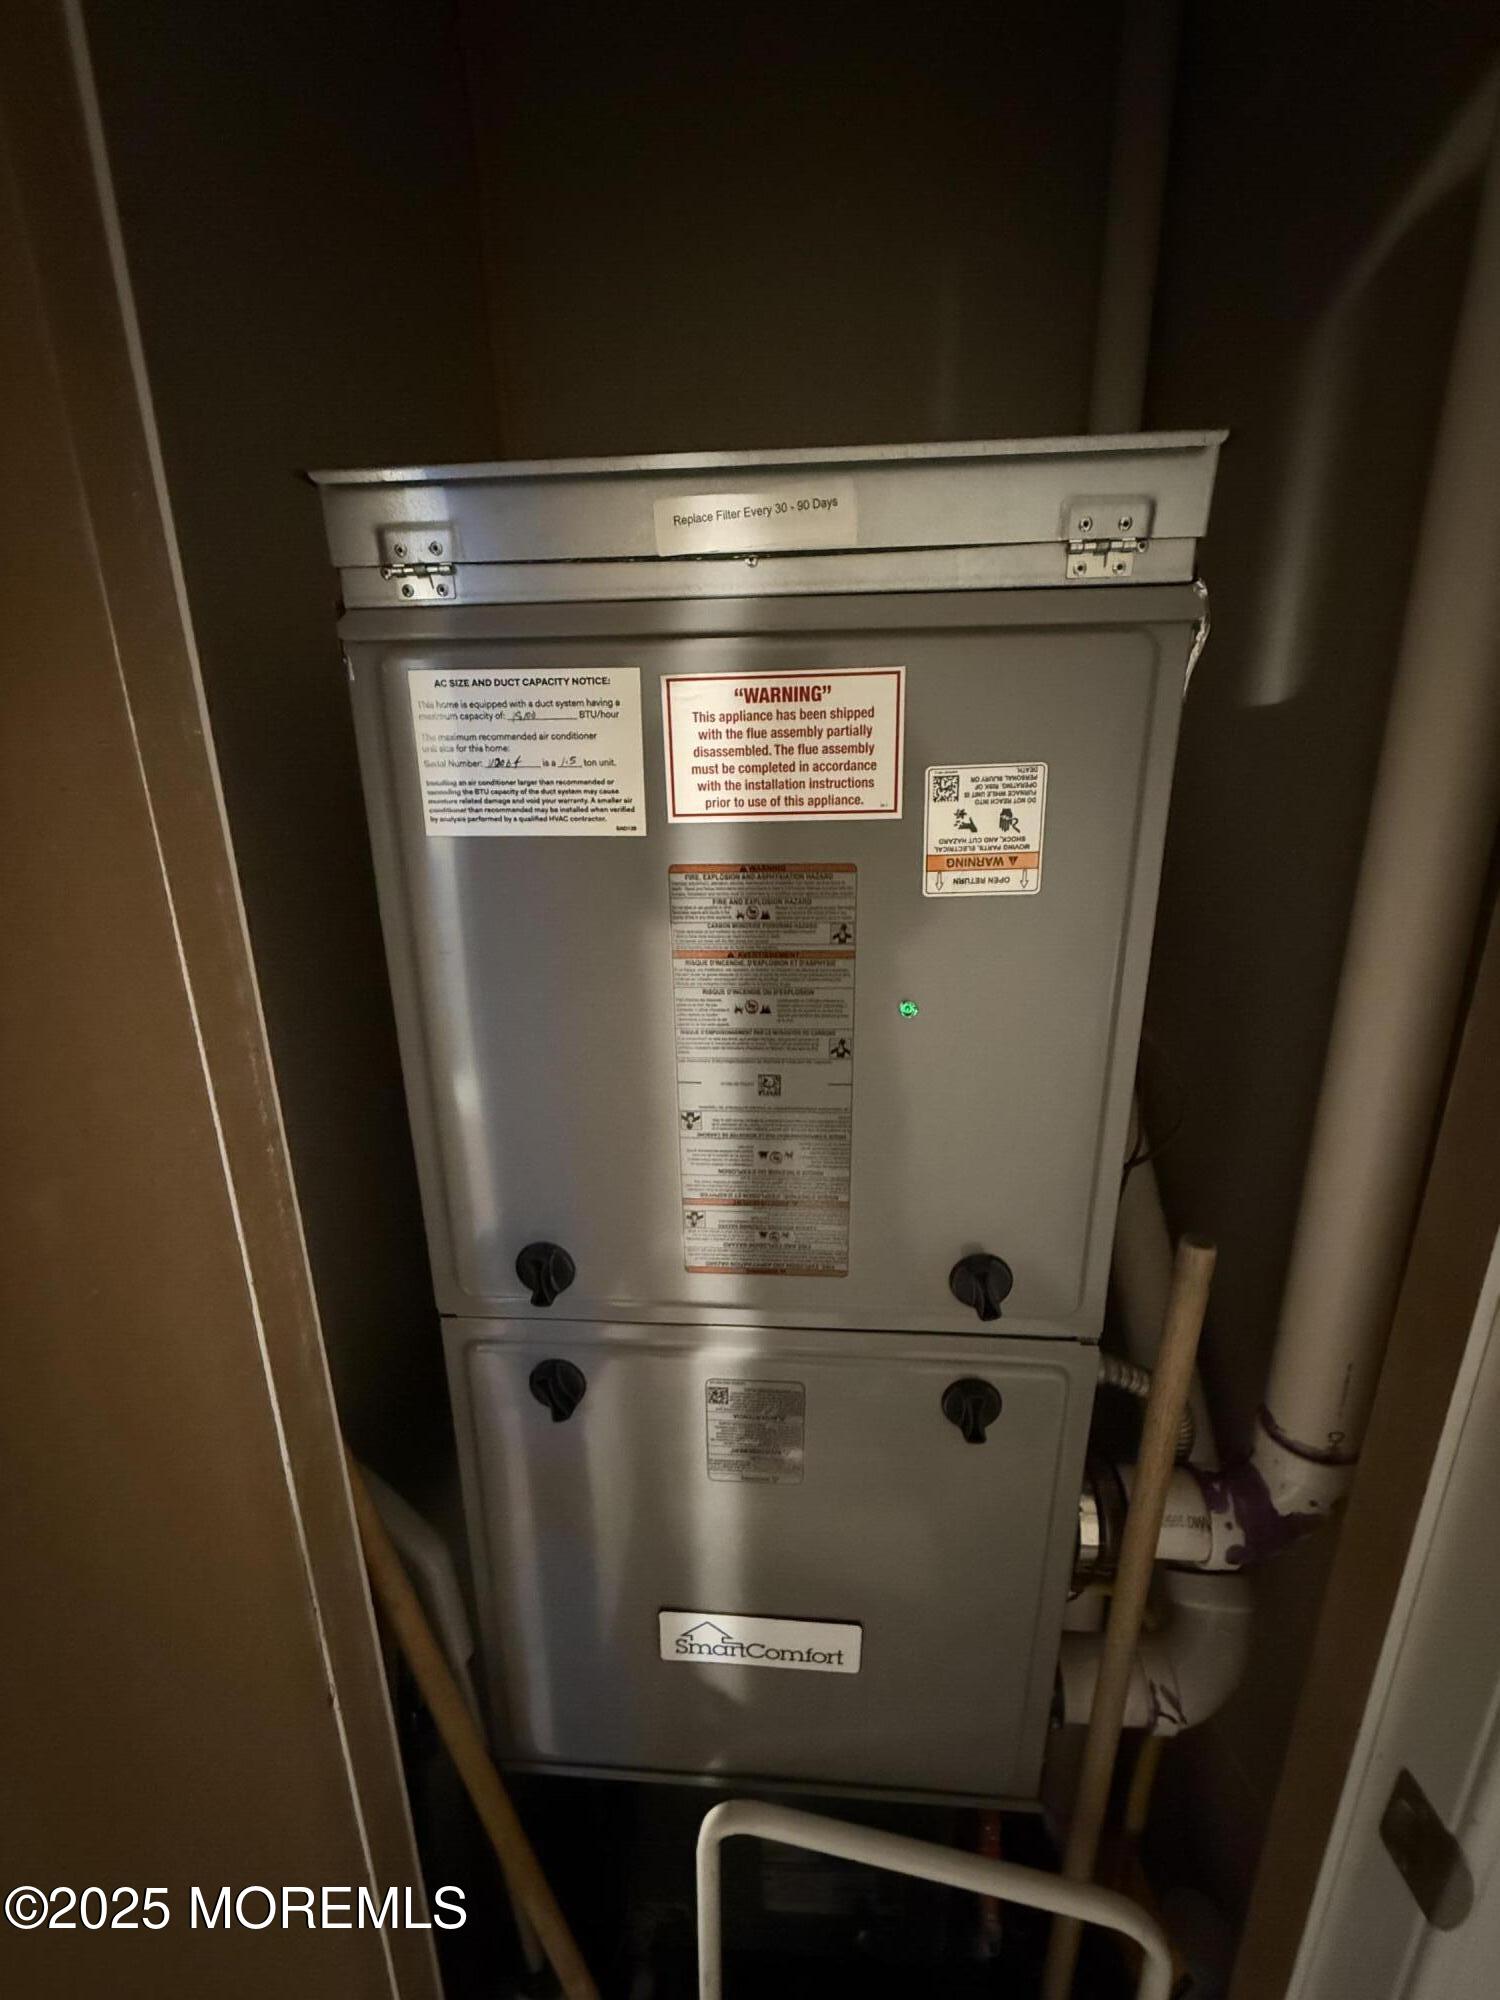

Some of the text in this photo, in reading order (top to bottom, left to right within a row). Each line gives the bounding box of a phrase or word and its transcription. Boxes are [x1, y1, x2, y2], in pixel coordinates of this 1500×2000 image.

[673, 513, 713, 526] Replace
[716, 510, 741, 520] Filter
[744, 506, 772, 518] Every
[775, 503, 787, 514] 30
[798, 500, 810, 511] 90
[813, 496, 838, 510] Days
[435, 679, 447, 688] AC
[450, 679, 469, 687] SIZE
[494, 678, 520, 686] DUCT
[522, 677, 569, 686] CAPACITY
[572, 677, 611, 685] NOTICE:
[461, 700, 467, 708] is
[469, 700, 507, 709] equipped
[510, 699, 527, 708] with
[535, 699, 553, 708] duct
[555, 700, 584, 709] system
[586, 698, 613, 708] having
[460, 712, 493, 721] capacity
[579, 710, 619, 719] BTU/hour
[692, 706, 875, 725] This appliance has been shipped
[551, 732, 596, 740] conditioner
[698, 724, 873, 740] with the flue assembly partially
[456, 744, 467, 752] for
[469, 744, 483, 752] this
[693, 742, 875, 758] disassembled. The flue assembly
[599, 758, 616, 766] unit.
[692, 759, 877, 776] must be completed in accordance
[697, 777, 874, 792] with the installation instructions
[705, 794, 864, 811] prior to use of this appliance.
[946, 857, 1004, 868] WARNING
[953, 876, 1010, 885] OPEN RETURN
[675, 1639, 844, 1665] SmartComfort
